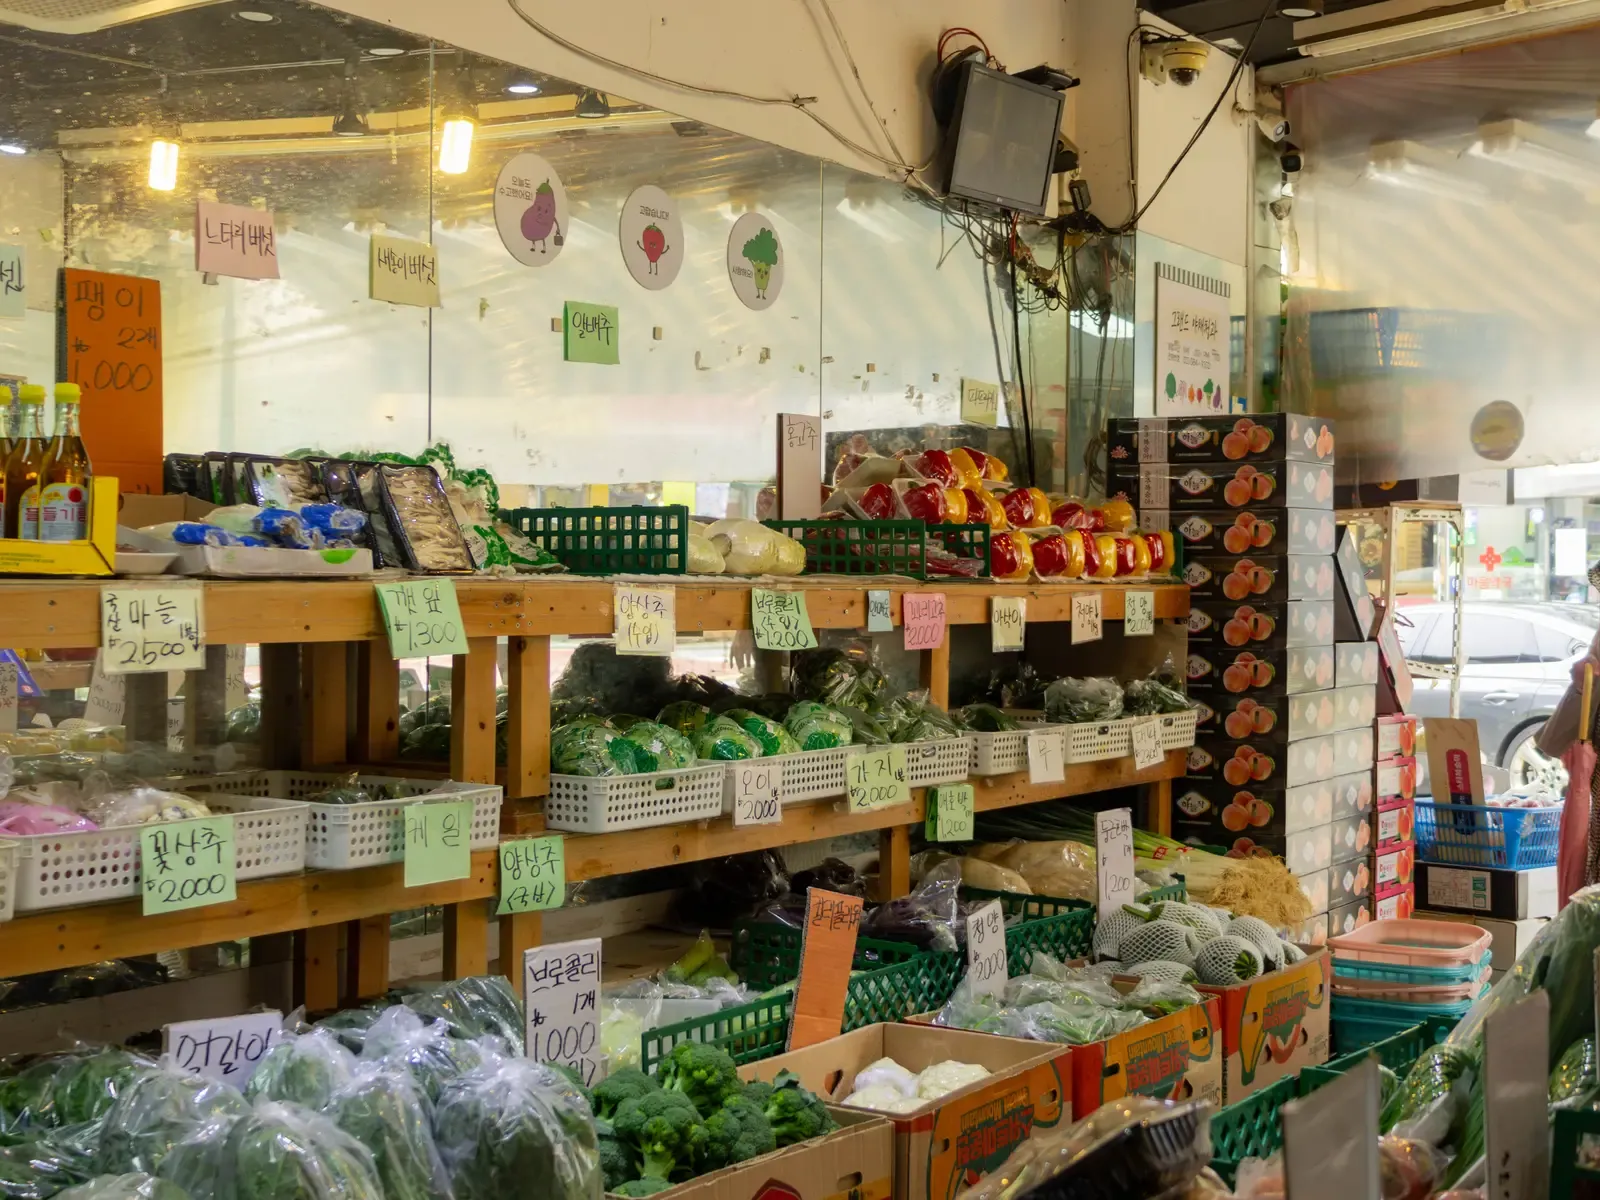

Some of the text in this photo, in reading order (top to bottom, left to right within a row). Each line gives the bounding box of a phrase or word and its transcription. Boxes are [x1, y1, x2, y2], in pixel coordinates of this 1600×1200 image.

[205, 217, 275, 257] 느타리버섯
[74, 280, 144, 322] 팽이
[786, 415, 818, 451] 홍고추
[128, 594, 177, 630] 마늘
[619, 592, 668, 620] 양상추
[742, 769, 771, 796] 오이
[851, 754, 893, 783] 가지
[148, 826, 228, 875] 꽃상추
[503, 840, 561, 880] 양상추
[529, 950, 600, 994] 브로콜리
[572, 989, 597, 1015] 1개
